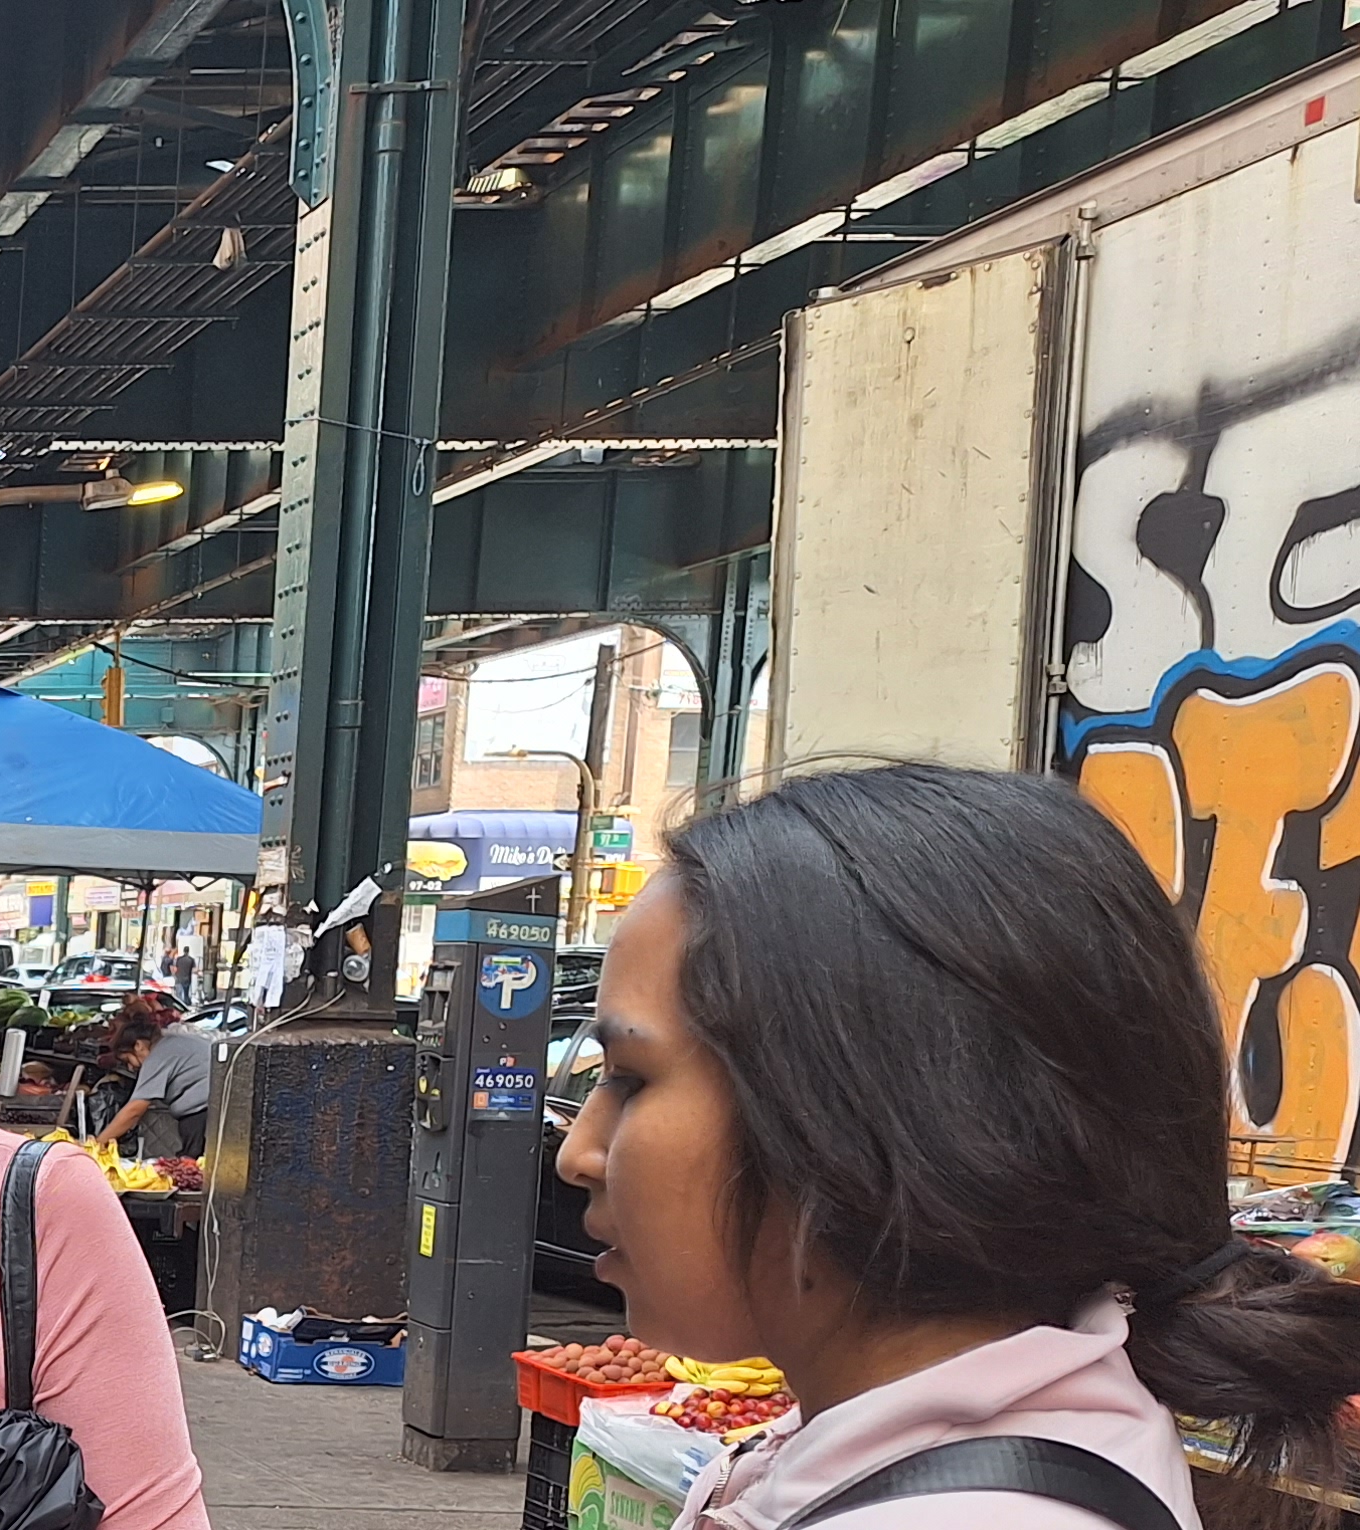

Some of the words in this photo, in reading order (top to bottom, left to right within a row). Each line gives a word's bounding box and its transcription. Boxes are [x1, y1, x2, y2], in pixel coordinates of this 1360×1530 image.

[490, 844, 535, 866] Mike's
[409, 881, 442, 891] 97-02
[475, 1074, 534, 1088] 469050
